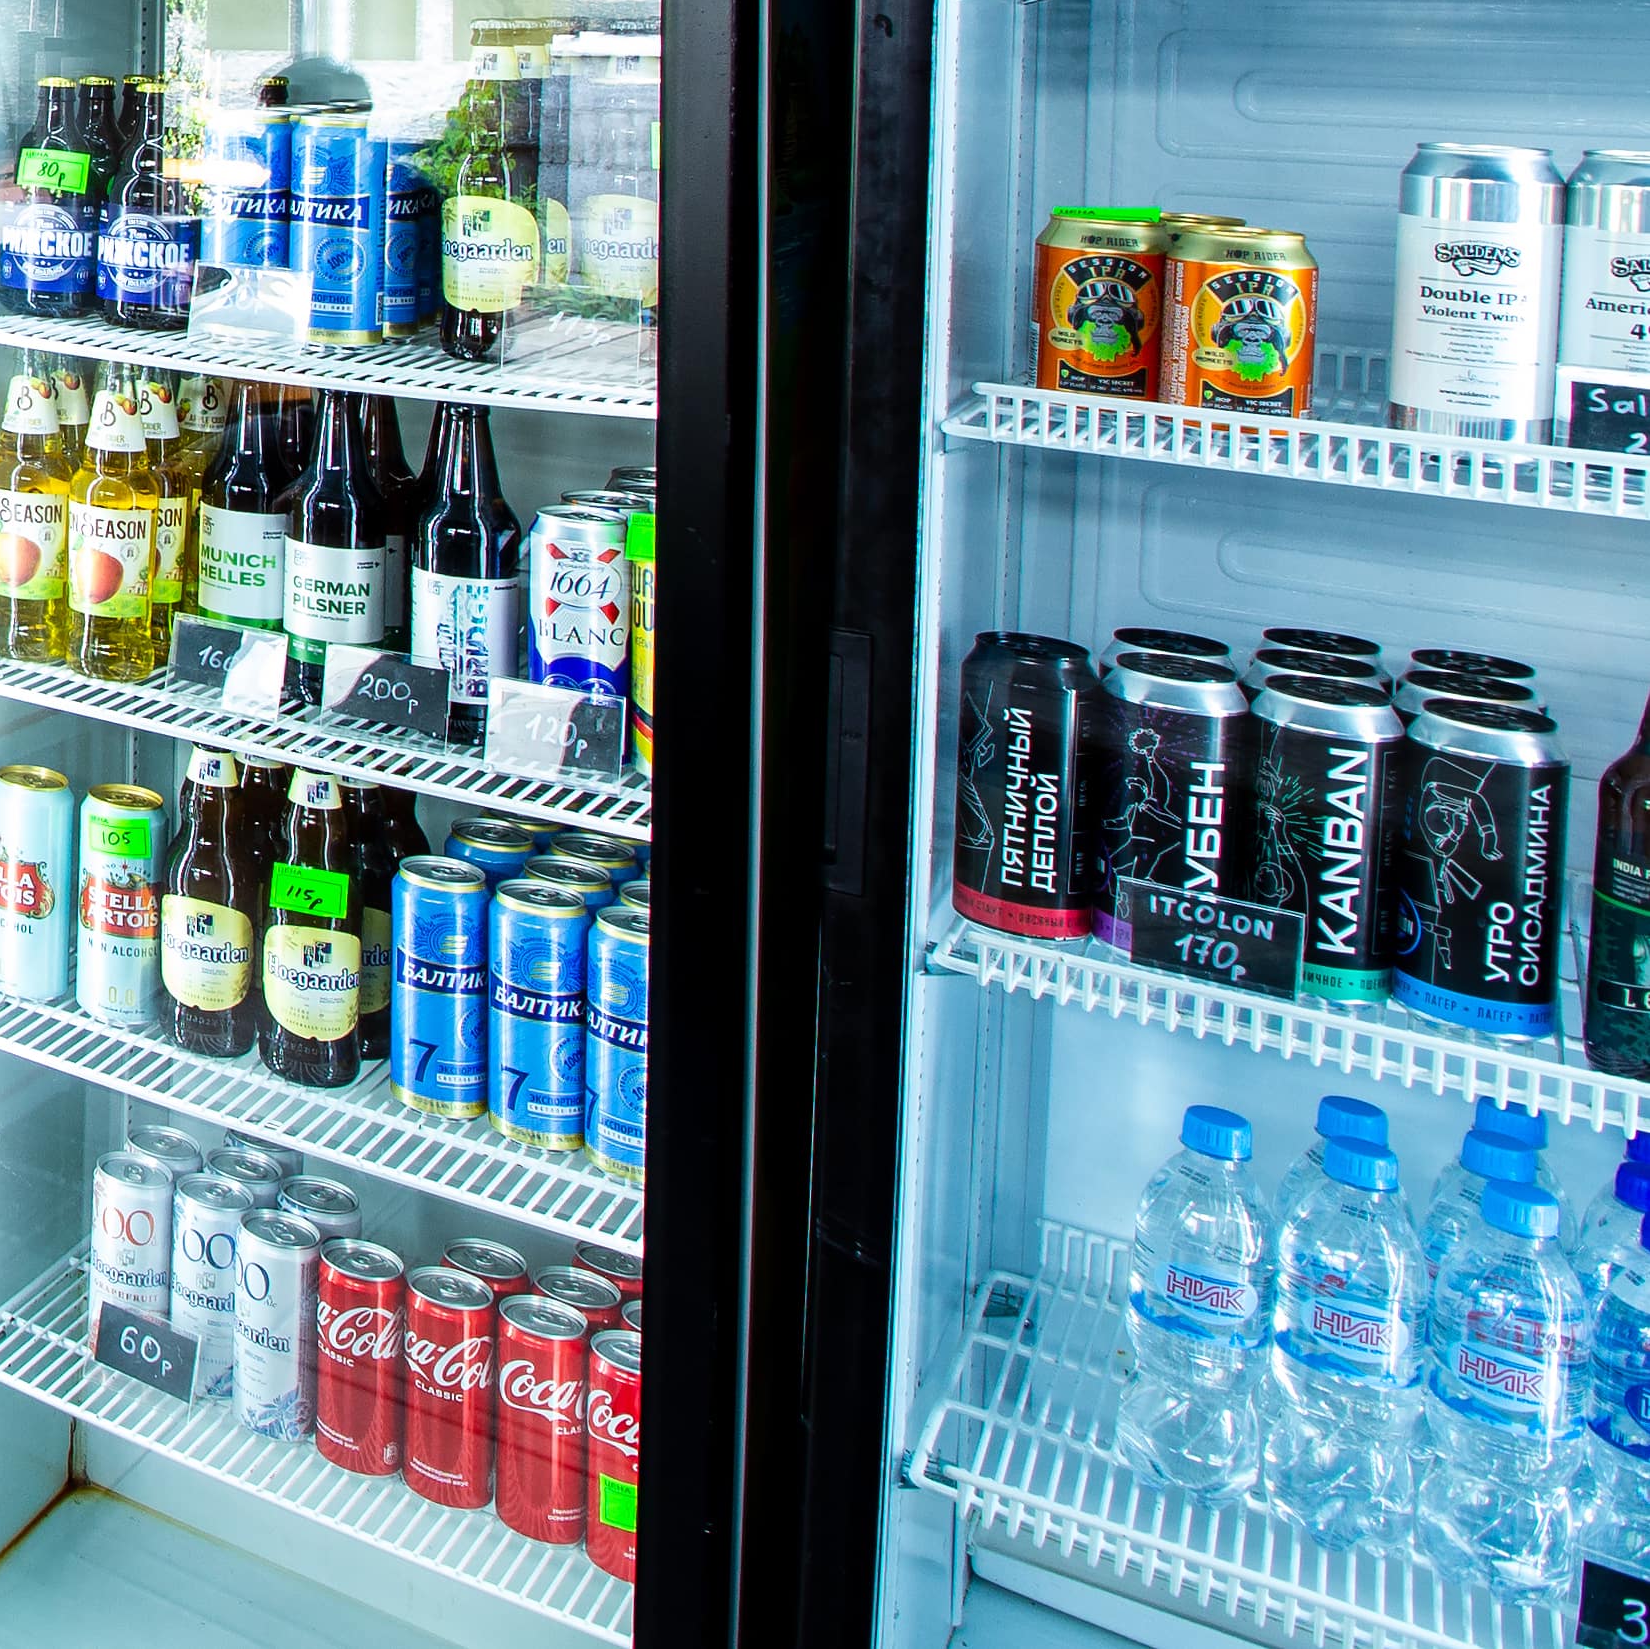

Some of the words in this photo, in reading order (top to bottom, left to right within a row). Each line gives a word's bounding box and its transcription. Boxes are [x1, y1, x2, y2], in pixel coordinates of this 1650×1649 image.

[443, 233, 532, 264] oegaarden
[1080, 234, 1103, 246] HOP
[1106, 236, 1139, 248] RIDER
[1434, 240, 1522, 268] SALDEN'S
[1225, 249, 1250, 261] HOP
[1253, 250, 1287, 262] RIDER
[1088, 266, 1125, 279] IPA
[1235, 281, 1272, 295] IPA
[1420, 284, 1492, 305] Double
[1421, 303, 1477, 321] Violent
[80, 513, 147, 543] SEASON
[201, 542, 277, 570] MUNICH
[201, 565, 266, 588] HELLES
[293, 575, 371, 598] GERMAN
[549, 570, 613, 600] 1664
[292, 592, 367, 616] PILSNER
[537, 619, 626, 647] BLANC
[1001, 705, 1034, 887] ПЯТНИЧНЫЙ
[101, 830, 132, 846] 105
[1029, 772, 1060, 894] ДЕПЛОЙ
[1316, 747, 1370, 957] KANBAN
[88, 885, 159, 911] STELLA
[1518, 782, 1553, 989] СИСАДМИНА
[87, 906, 160, 928] ARTOIS
[1149, 895, 1275, 941] ITCOLON
[1484, 900, 1517, 985] УТРО
[267, 949, 361, 992] Hoegaarden
[402, 963, 488, 990] БАЛТИК
[494, 986, 587, 1019] БАЛТИК
[1424, 991, 1463, 1014] ЛАГЕР
[1476, 1005, 1516, 1026] ЛАГЕР
[409, 1038, 439, 1083] 7
[501, 1063, 531, 1111] 7
[414, 1379, 464, 1403] CLASSIC
